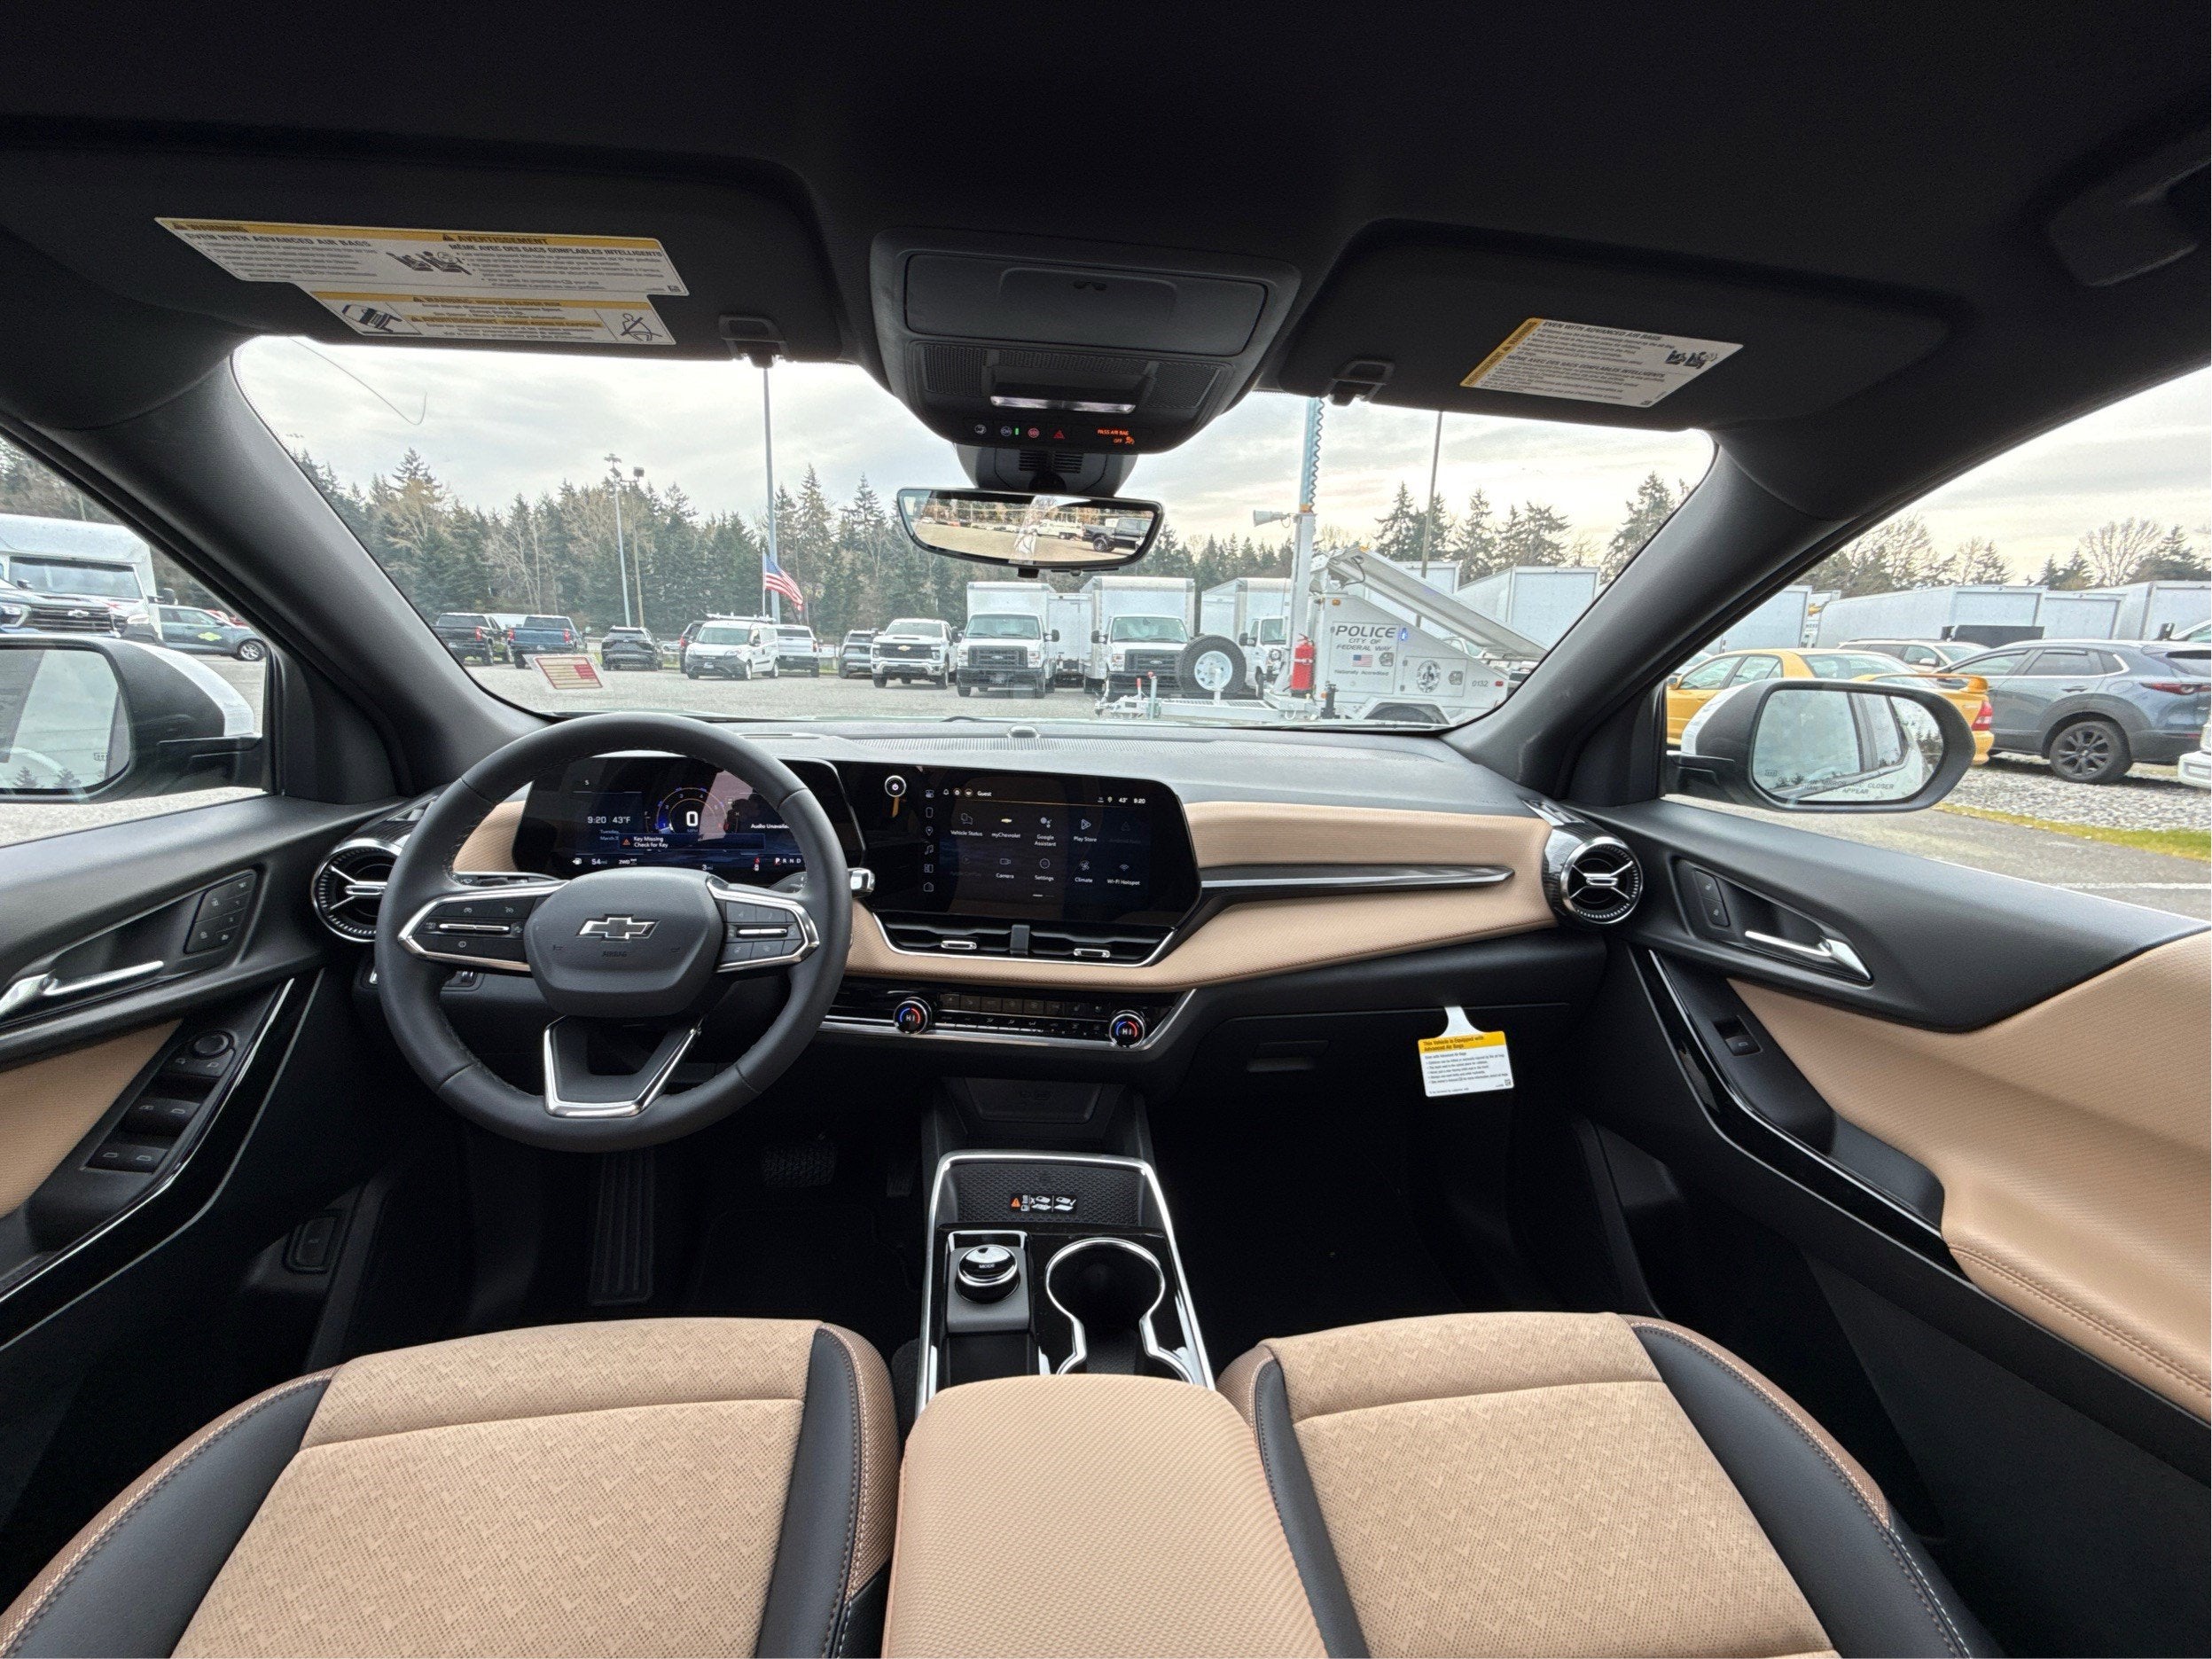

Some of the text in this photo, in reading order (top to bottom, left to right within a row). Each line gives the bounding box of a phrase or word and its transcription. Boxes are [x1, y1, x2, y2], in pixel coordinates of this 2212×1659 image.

[252, 236, 315, 245] ADVANCED
[457, 235, 550, 246] AVERTISSEMENT
[1583, 325, 1627, 336] ADVANCED
[1335, 625, 1397, 638] POLICE
[587, 816, 607, 825] 9:20
[685, 810, 699, 827] 0
[1034, 873, 1055, 882] Settings
